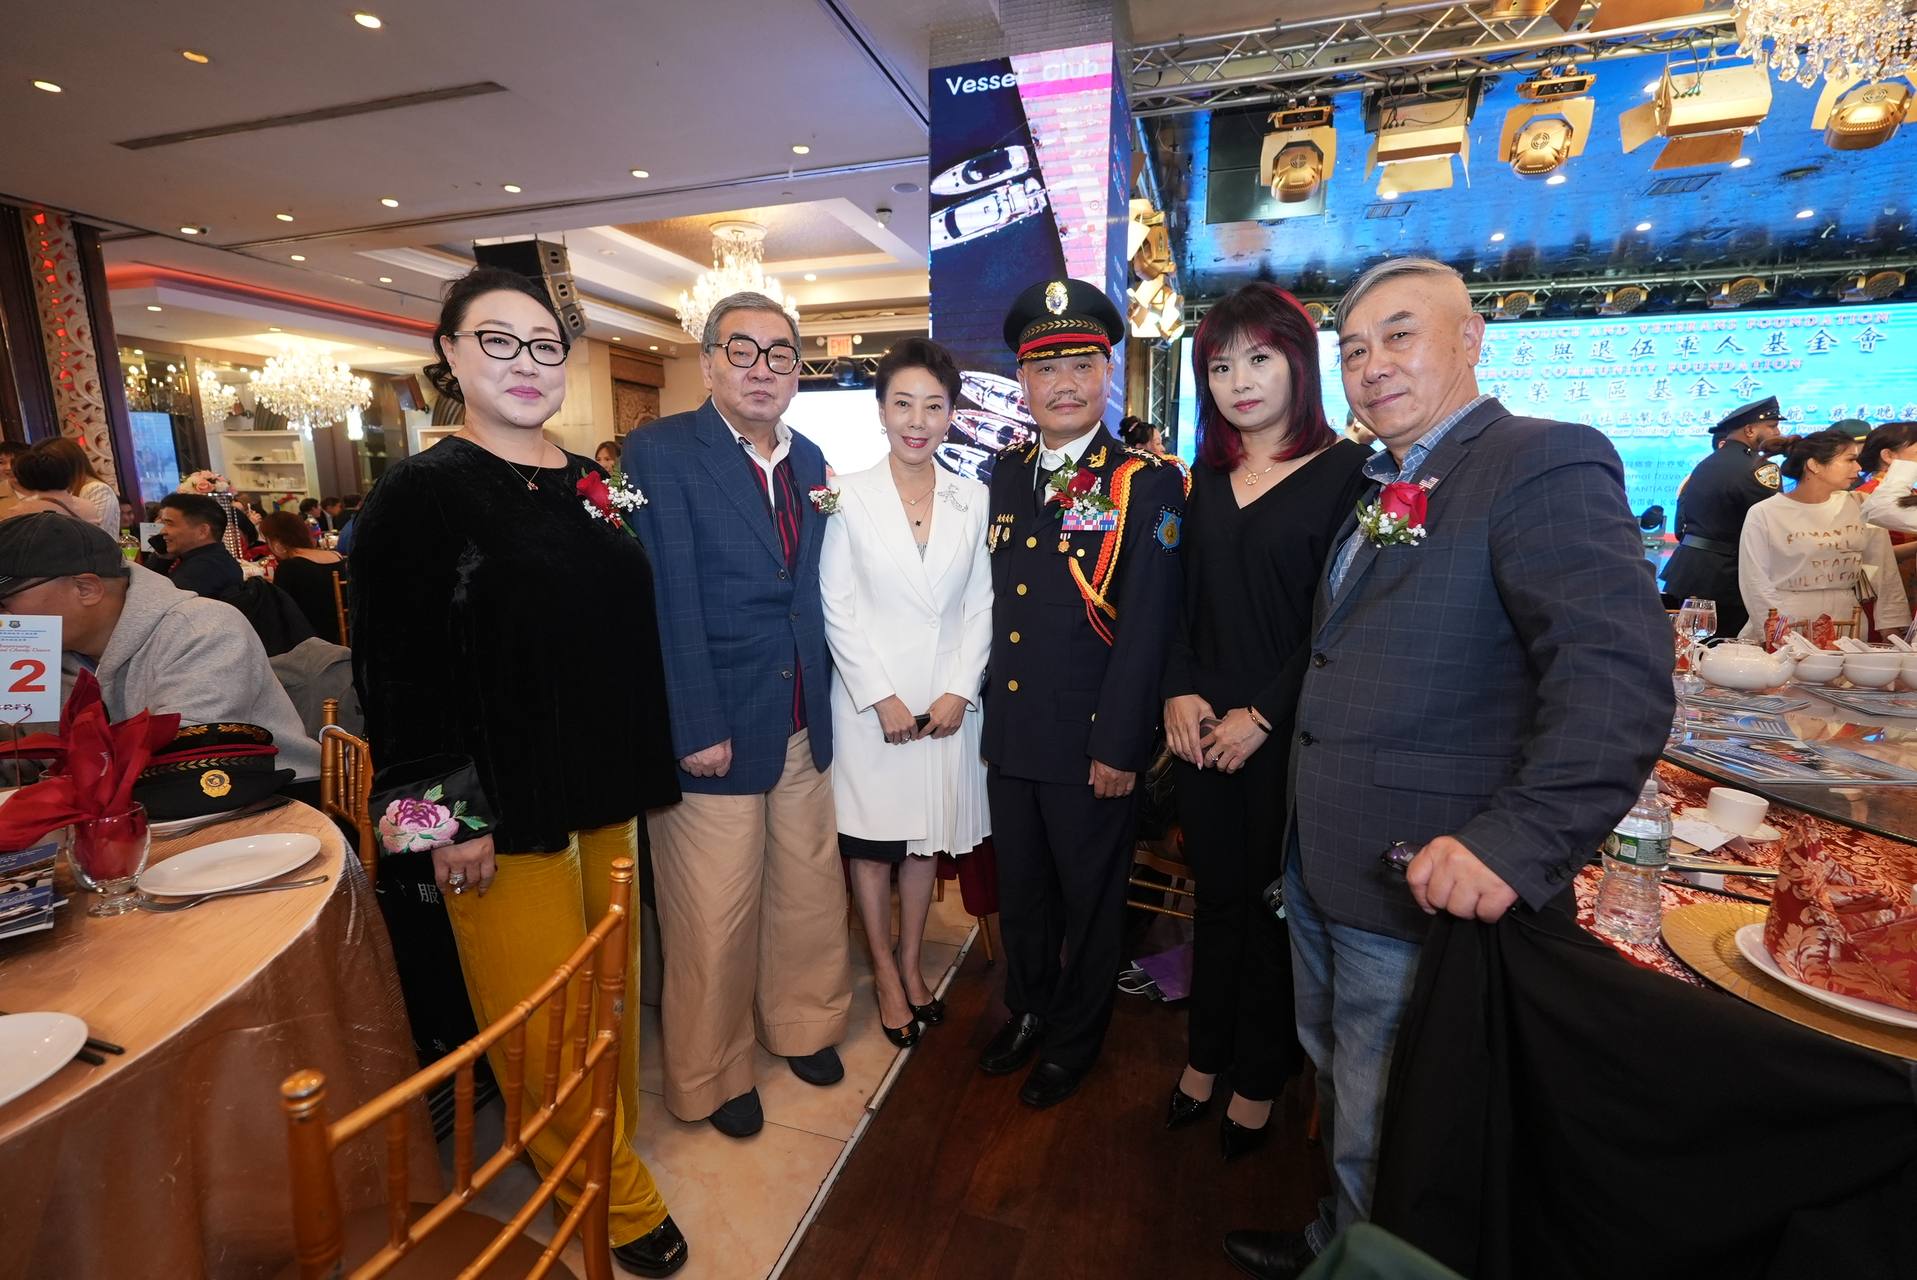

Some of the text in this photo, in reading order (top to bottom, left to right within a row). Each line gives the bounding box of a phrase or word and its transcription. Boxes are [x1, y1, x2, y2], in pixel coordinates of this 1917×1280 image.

[1042, 58, 1099, 81] Club
[1518, 327, 1580, 340] POLICE
[1589, 324, 1630, 337] AND
[1639, 319, 1738, 335] VETERANS
[1746, 312, 1890, 330] FOUNDATION
[1541, 363, 1658, 378] COMMUNITY
[1667, 358, 1804, 375] FOUNDATION
